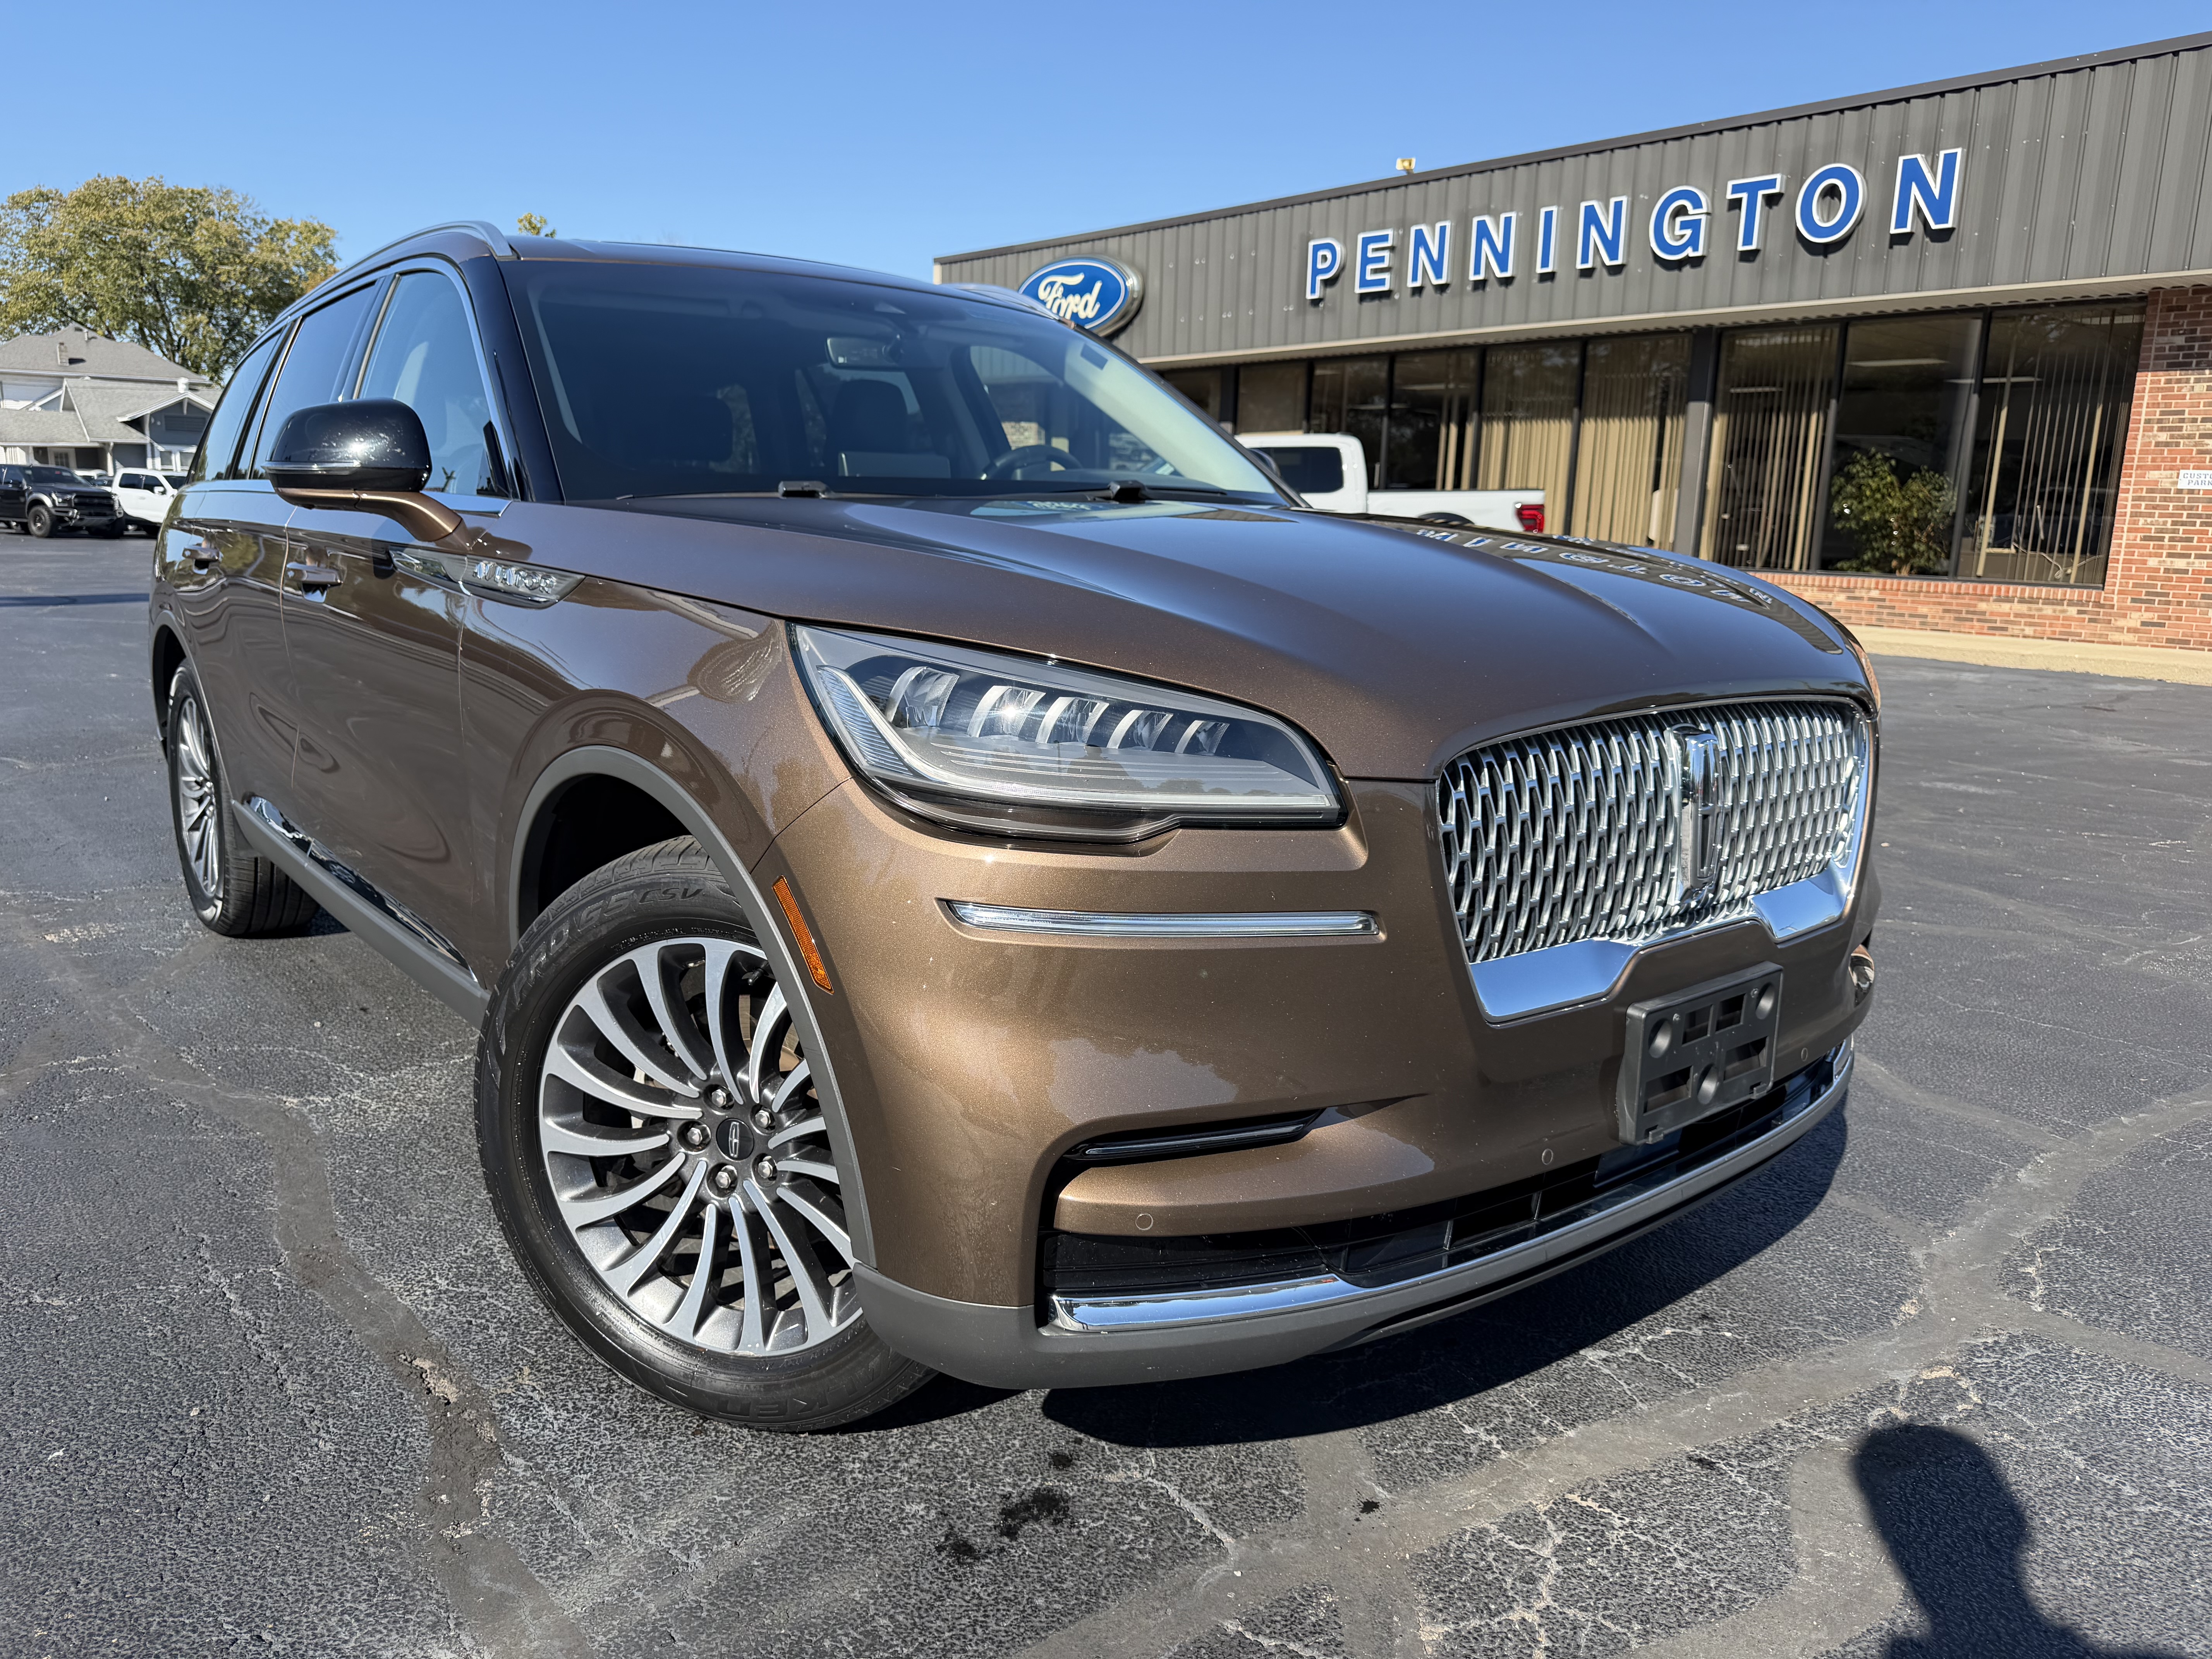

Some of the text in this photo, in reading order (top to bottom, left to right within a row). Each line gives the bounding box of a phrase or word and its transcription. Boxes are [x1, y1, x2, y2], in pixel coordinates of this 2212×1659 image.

[1306, 147, 1963, 300] PENNINGTON
[1038, 272, 1103, 319] Ford
[577, 889, 635, 931] G5
[639, 888, 703, 905] CSV
